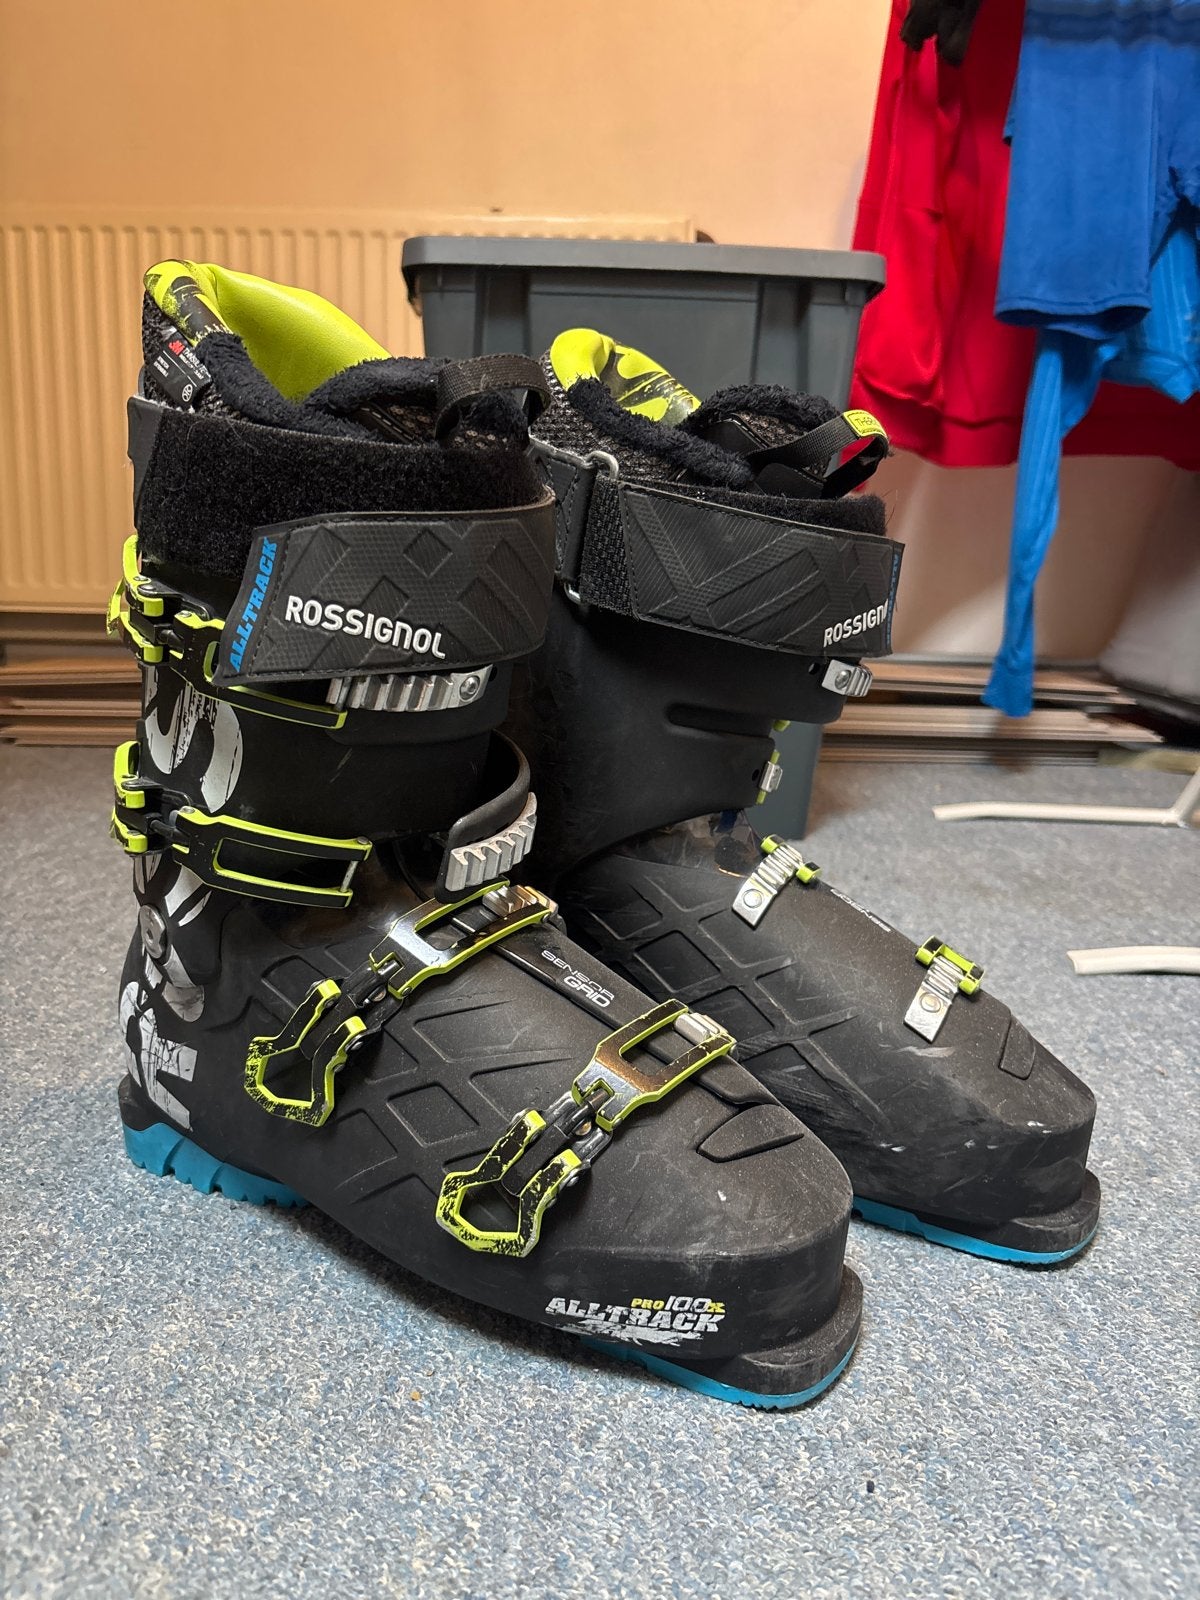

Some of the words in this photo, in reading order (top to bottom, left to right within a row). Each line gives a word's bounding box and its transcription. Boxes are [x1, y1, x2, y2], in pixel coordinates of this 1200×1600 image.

[229, 536, 277, 673] ALLTRACK
[285, 595, 446, 659] ROSSIGNOL
[541, 949, 615, 1001] SENSOR
[563, 975, 611, 1008] GRID
[545, 1297, 726, 1333] ALLTRACK
